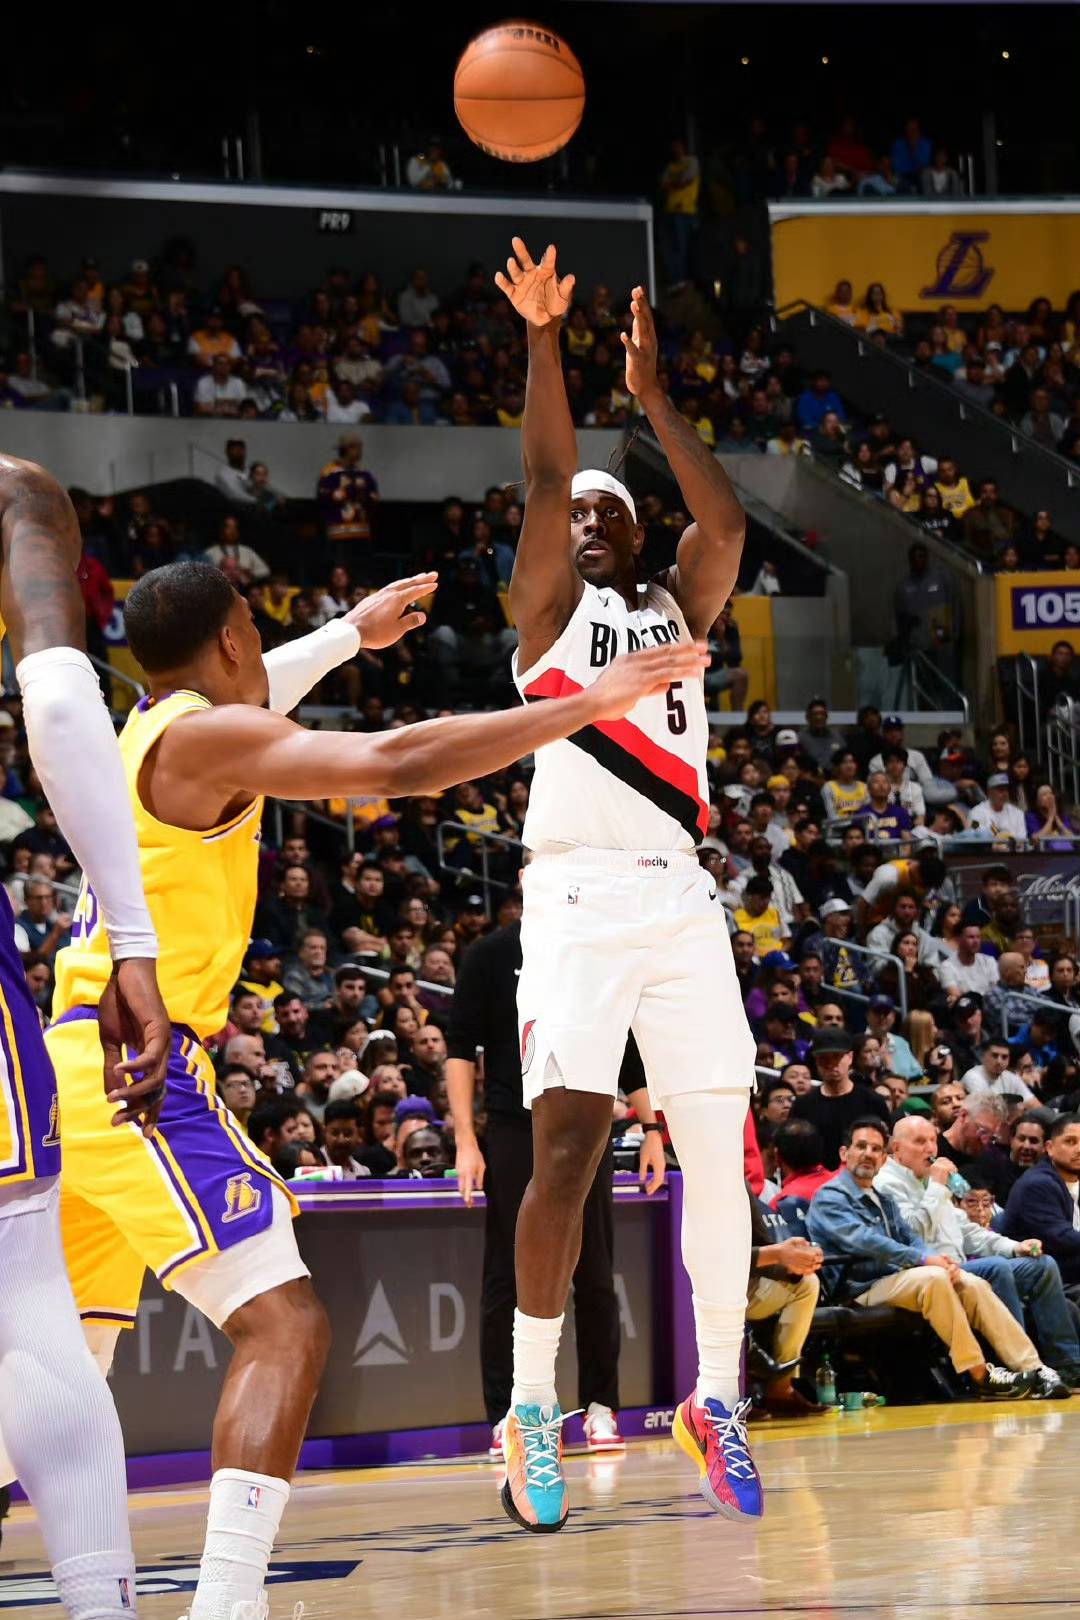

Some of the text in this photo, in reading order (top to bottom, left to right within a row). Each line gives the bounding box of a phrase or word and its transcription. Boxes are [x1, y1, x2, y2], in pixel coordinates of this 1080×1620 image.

[1020, 592, 1080, 624] 105
[666, 680, 687, 736] 5
[637, 856, 668, 868] ripcity
